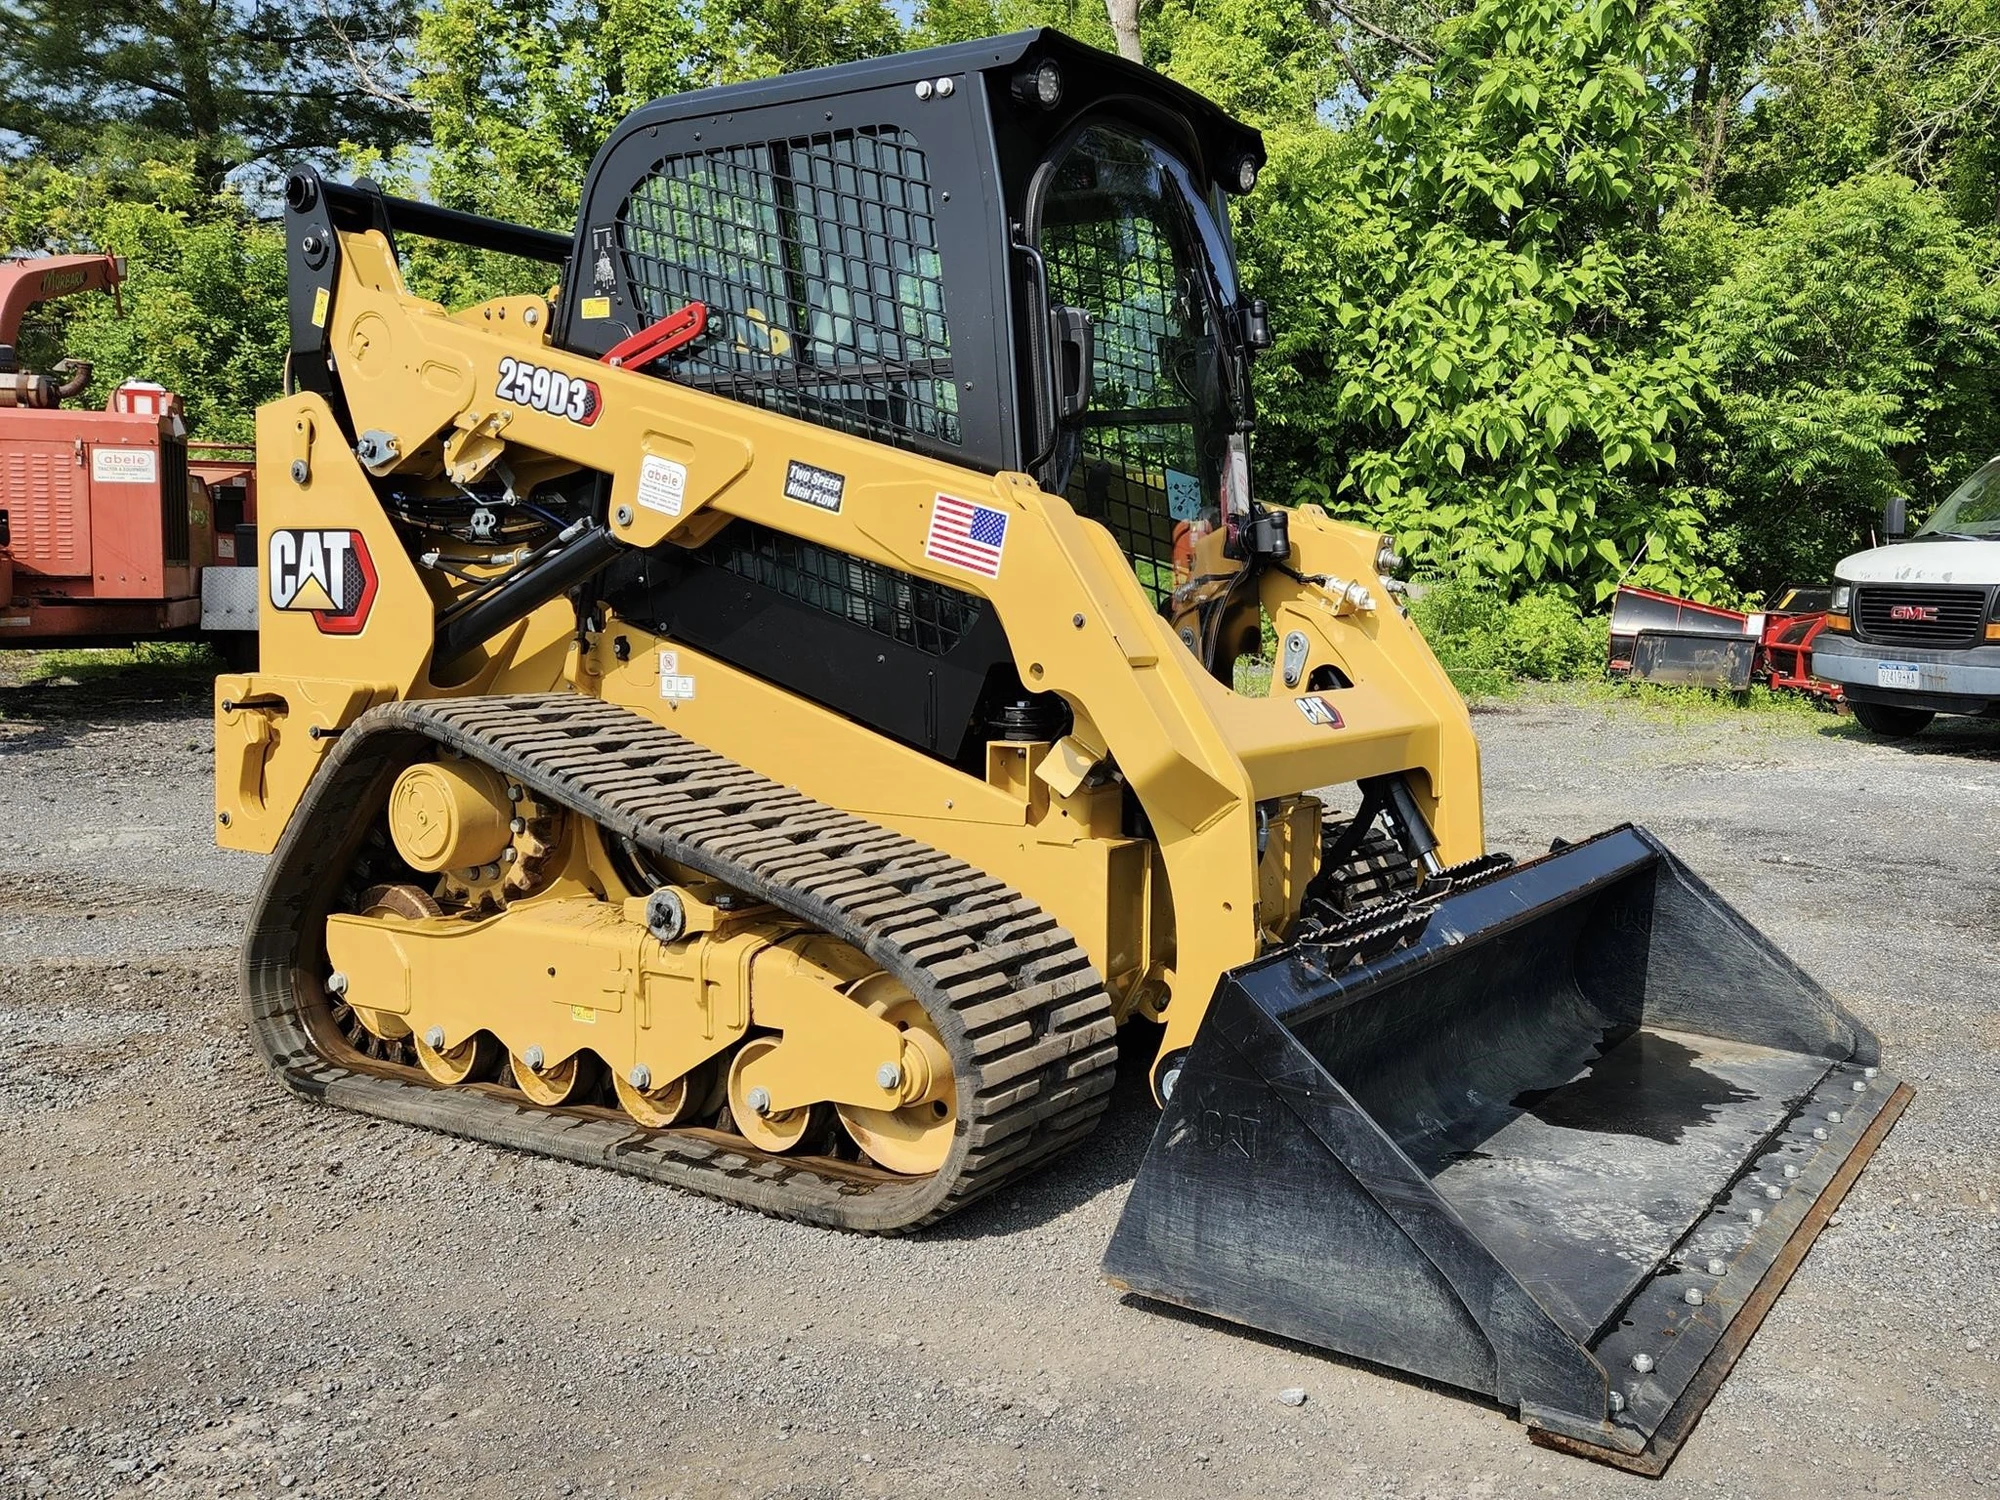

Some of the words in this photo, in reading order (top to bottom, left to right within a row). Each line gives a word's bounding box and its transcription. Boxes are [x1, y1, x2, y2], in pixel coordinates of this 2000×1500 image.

[496, 357, 588, 421] 259D3
[104, 454, 145, 465] abele
[647, 468, 678, 487] abele
[790, 465, 811, 482] TWO
[811, 472, 841, 491] SPEED
[787, 482, 811, 500] HIGH
[811, 489, 838, 508] FLOW
[269, 531, 350, 610] CAT
[1891, 605, 1939, 621] GMC
[1295, 697, 1336, 724] CAT
[1203, 1110, 1261, 1160] CAT
